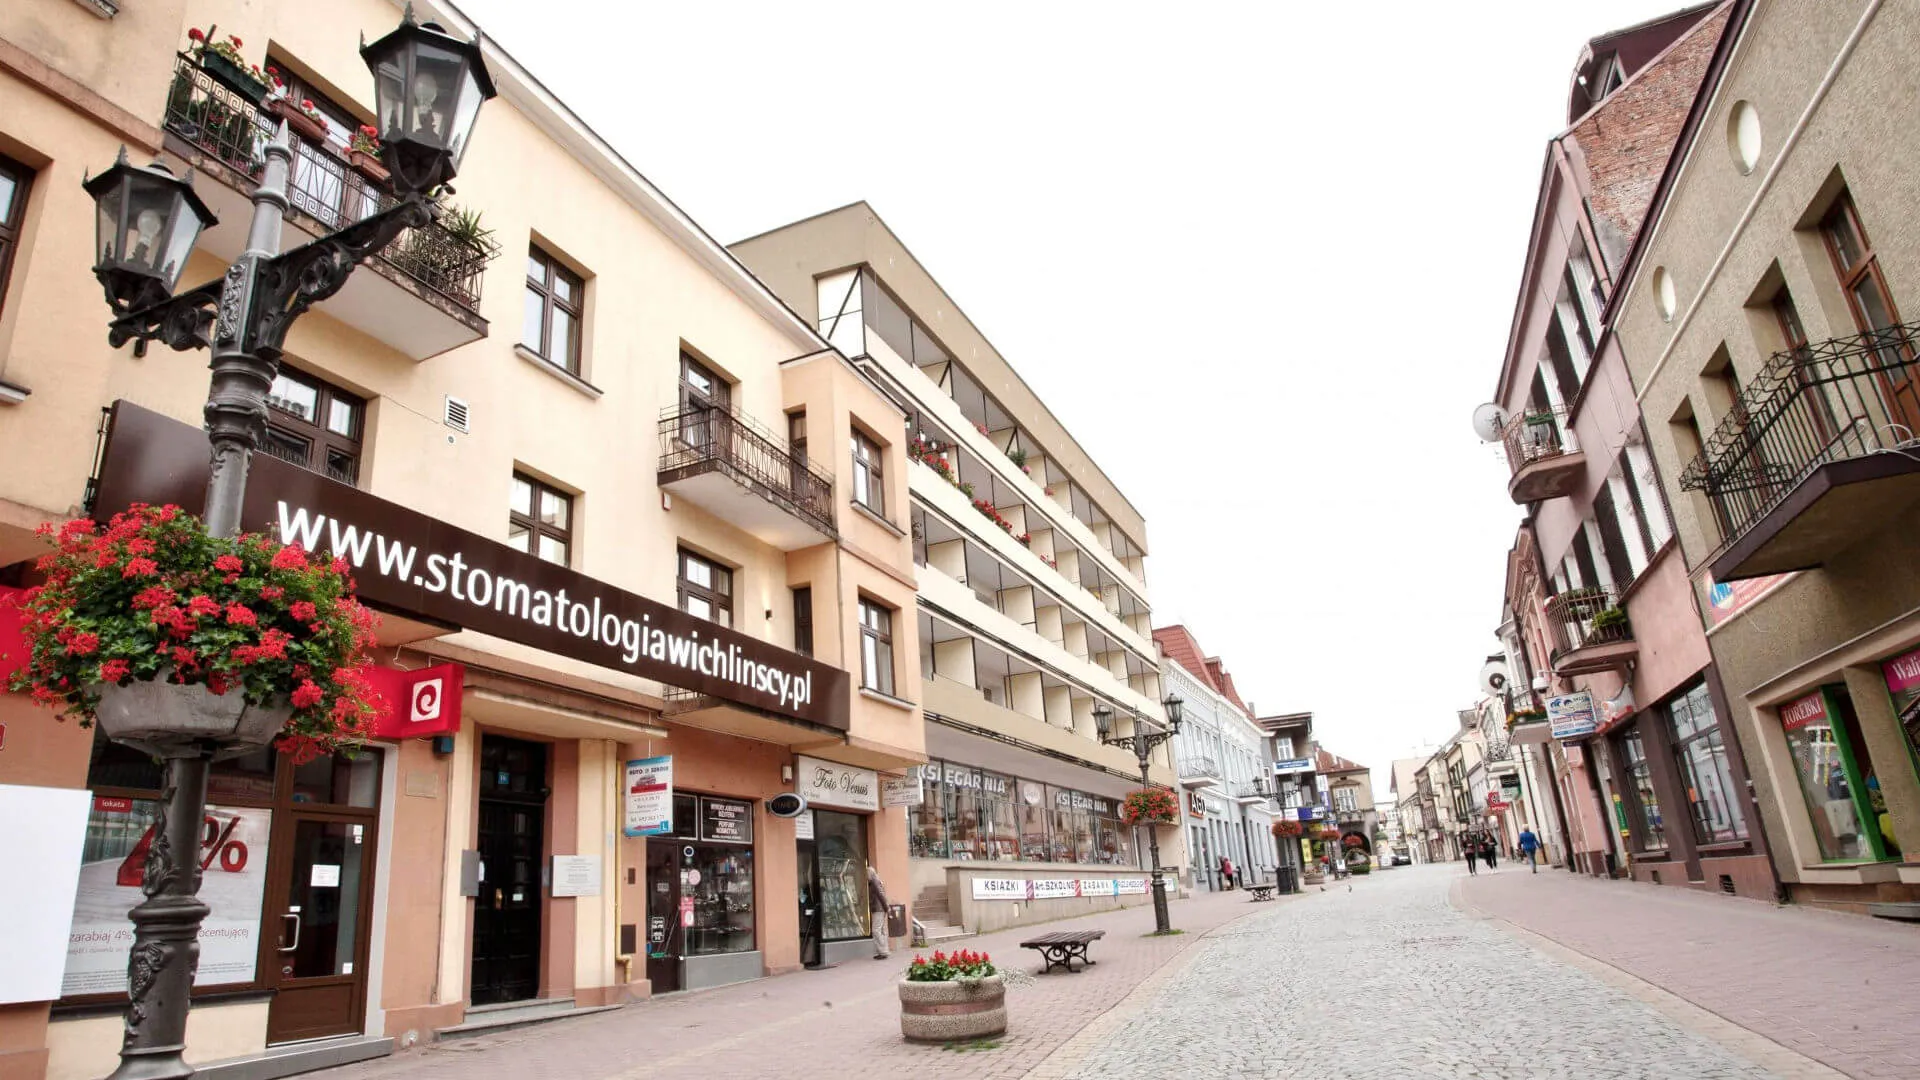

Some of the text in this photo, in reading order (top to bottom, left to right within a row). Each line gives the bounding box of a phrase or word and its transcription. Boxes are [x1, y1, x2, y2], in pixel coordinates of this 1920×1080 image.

[277, 500, 811, 711] www.stomatologiawichlinscy.pl
[1784, 695, 1822, 725] TOREBKI
[813, 766, 837, 790] Foto
[102, 799, 125, 808] lokata
[199, 927, 249, 939] ocentującej
